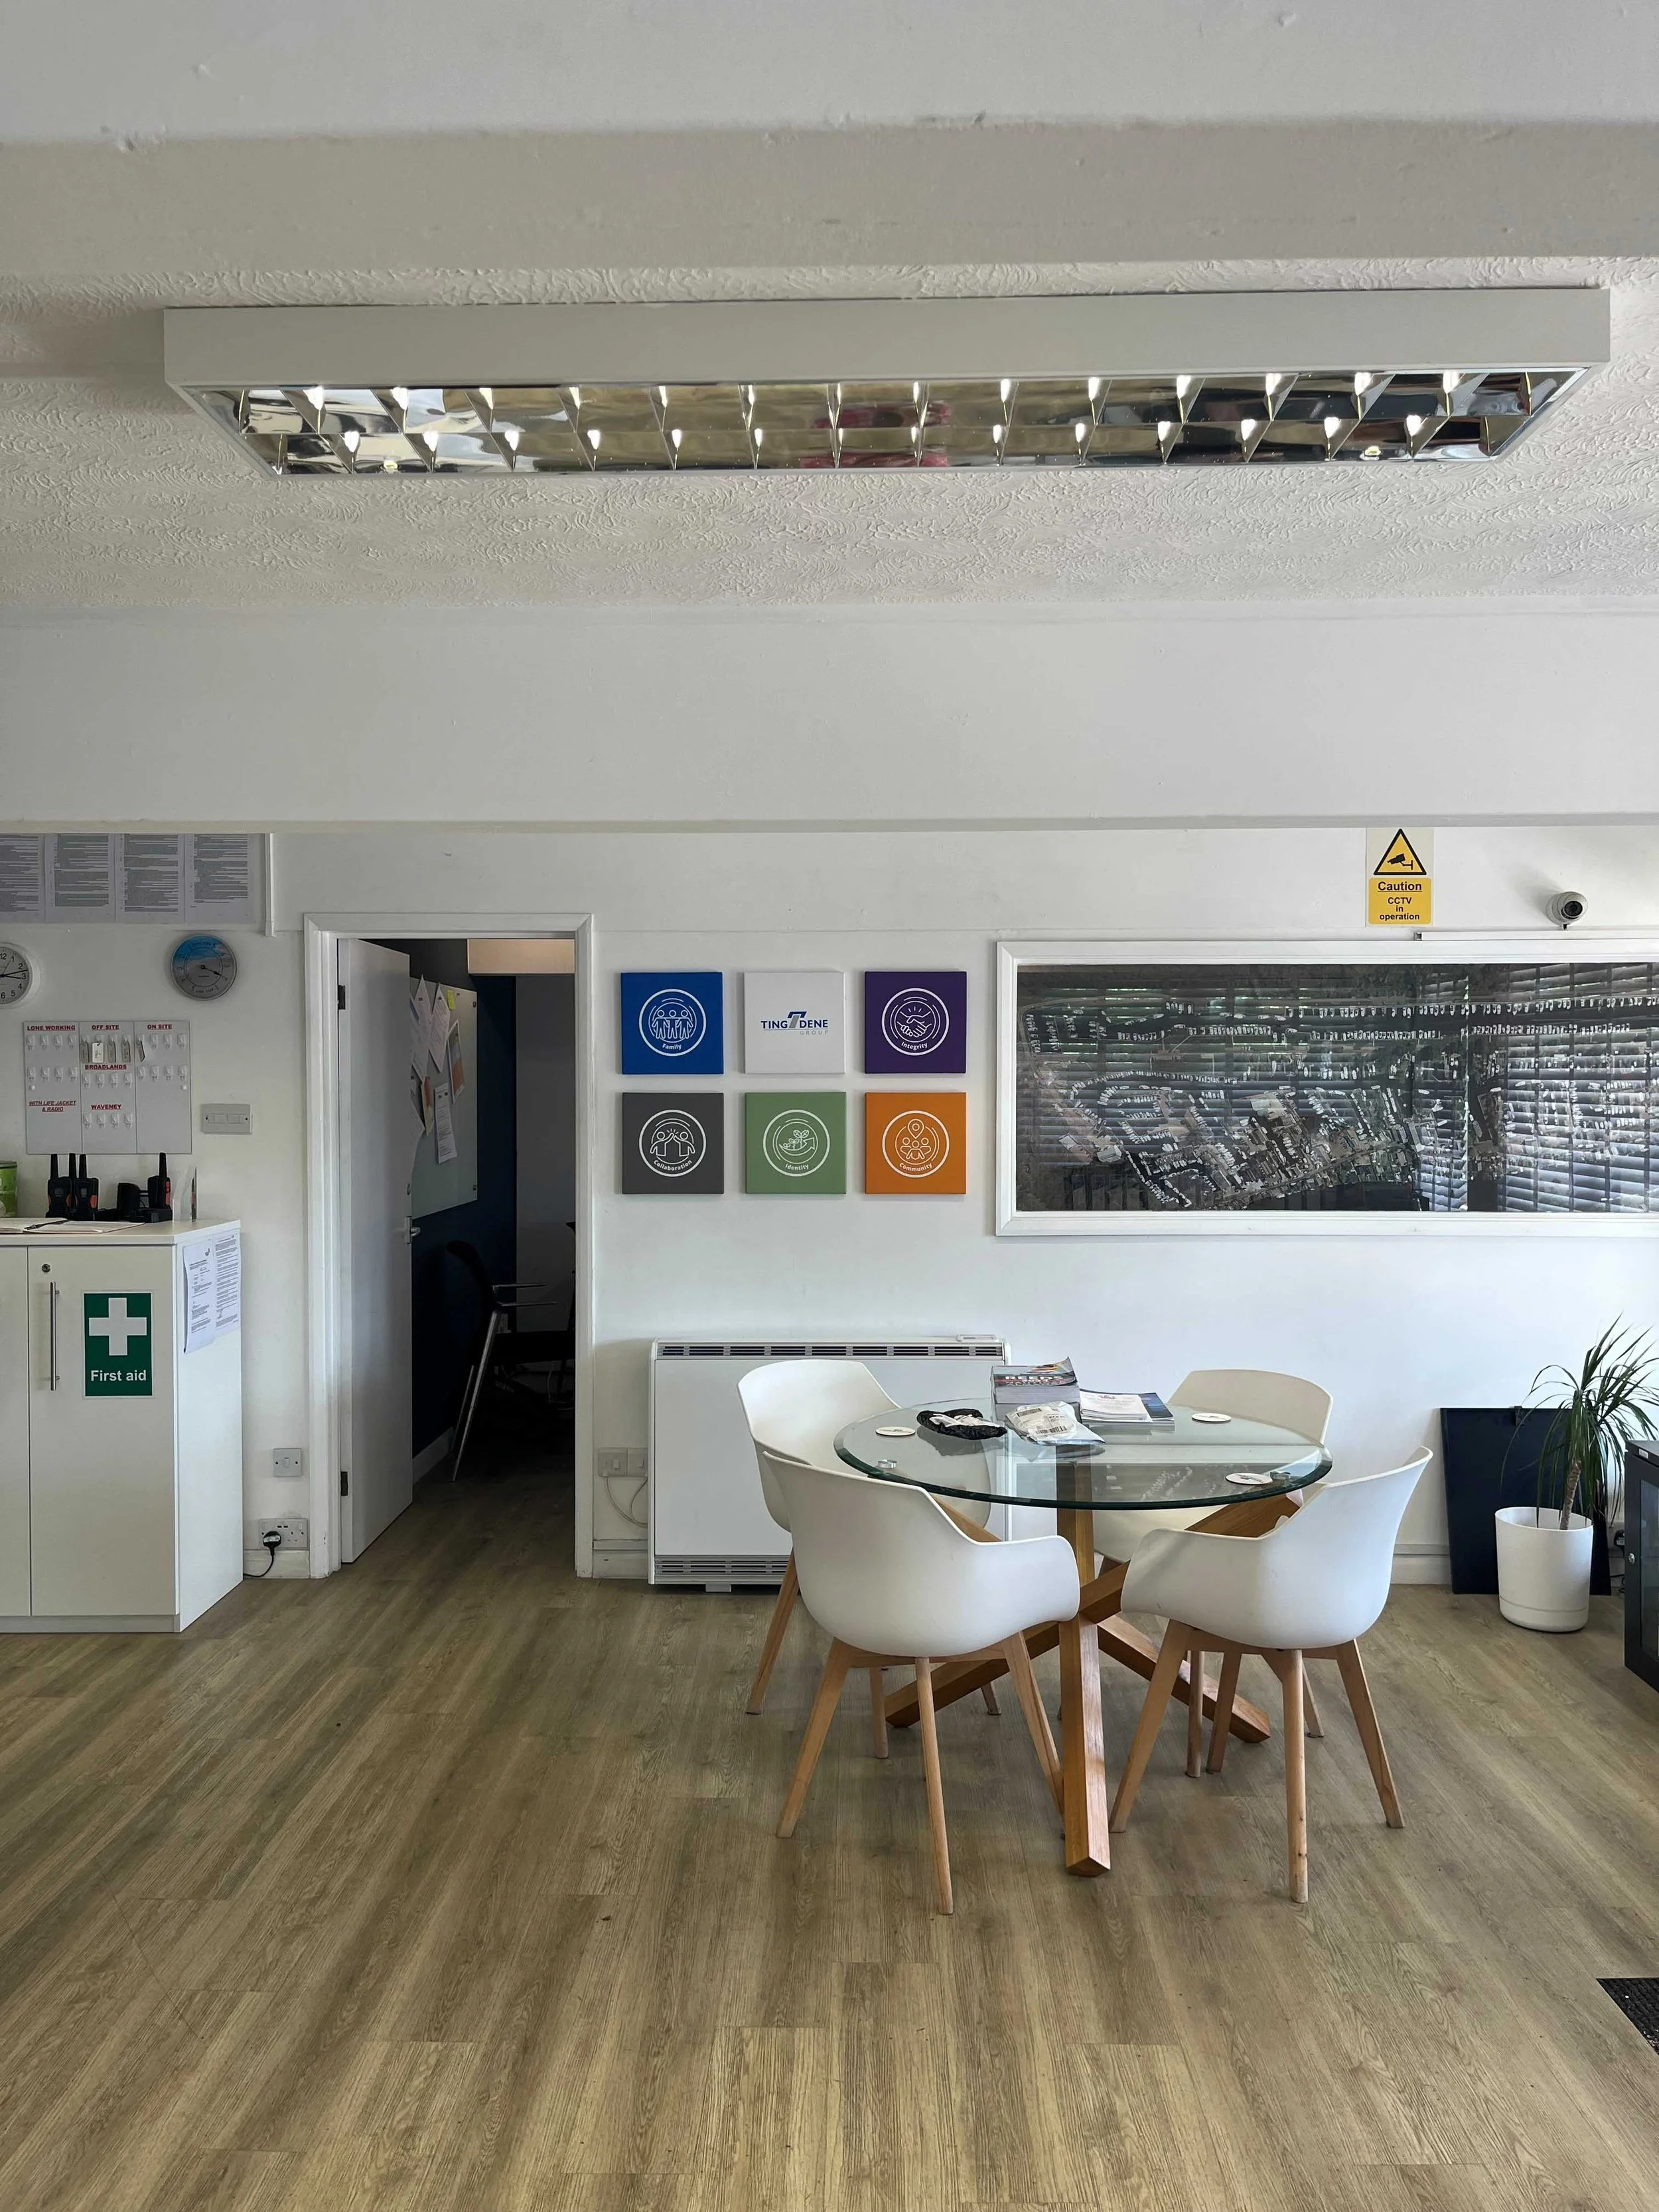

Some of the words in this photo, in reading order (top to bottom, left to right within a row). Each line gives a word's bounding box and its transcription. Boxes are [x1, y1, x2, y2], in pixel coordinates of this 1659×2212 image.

[1378, 881, 1422, 891] Caution
[901, 1041, 928, 1051] Integrity
[653, 1159, 693, 1171] Collaboration
[899, 1163, 932, 1172] Community
[91, 1370, 122, 1381] First
[126, 1370, 147, 1381] aid
